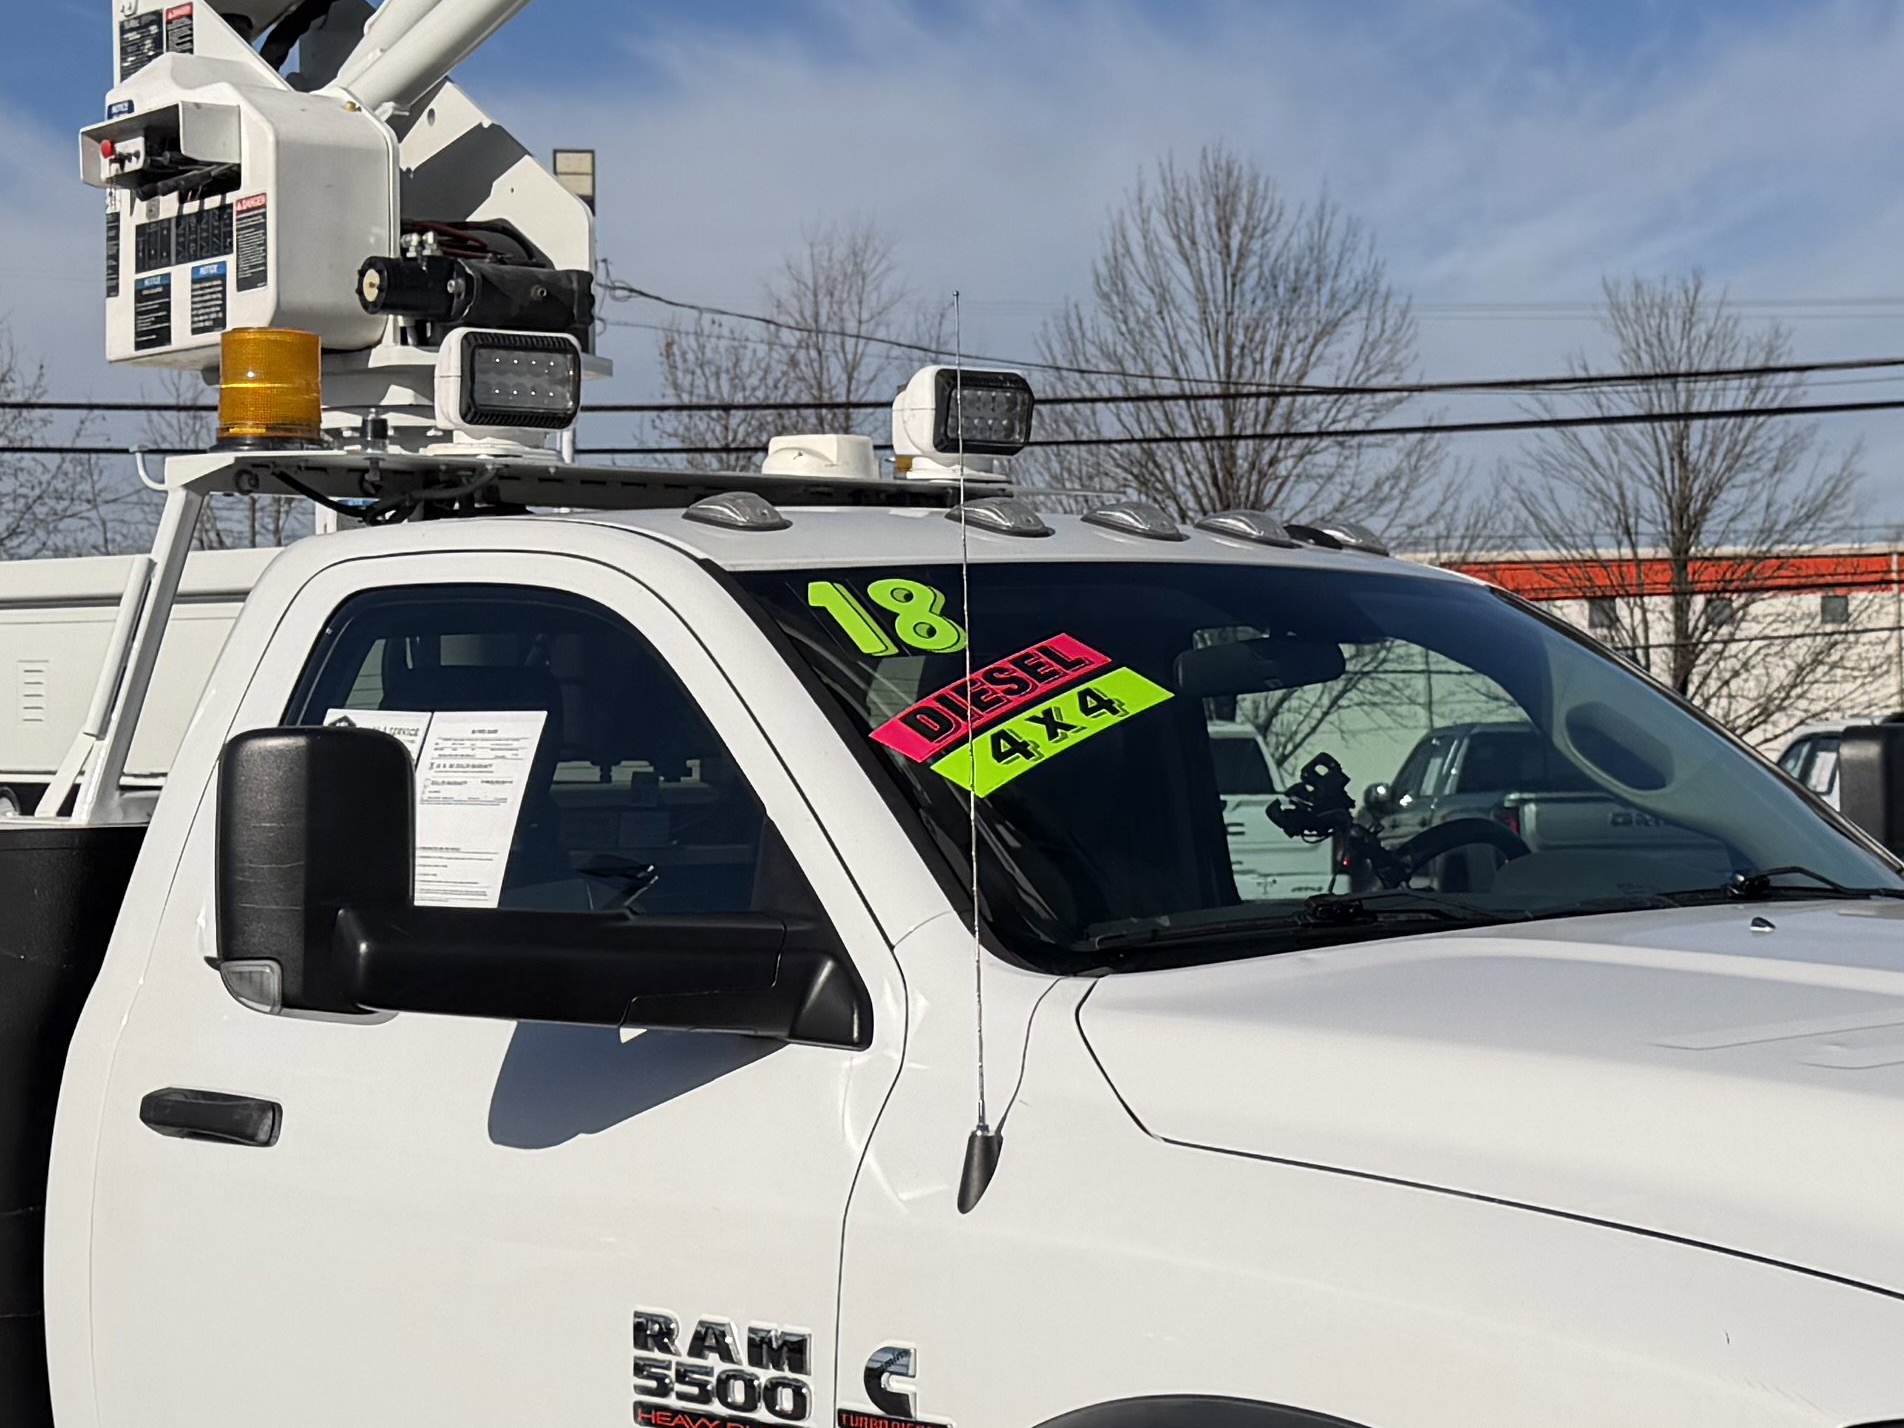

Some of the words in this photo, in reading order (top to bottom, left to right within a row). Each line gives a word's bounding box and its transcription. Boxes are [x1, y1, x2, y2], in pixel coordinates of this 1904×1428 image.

[807, 578, 969, 657] 18
[899, 644, 1096, 744] DIESEL
[633, 1309, 813, 1376] RAM
[633, 1355, 814, 1422] 5500
